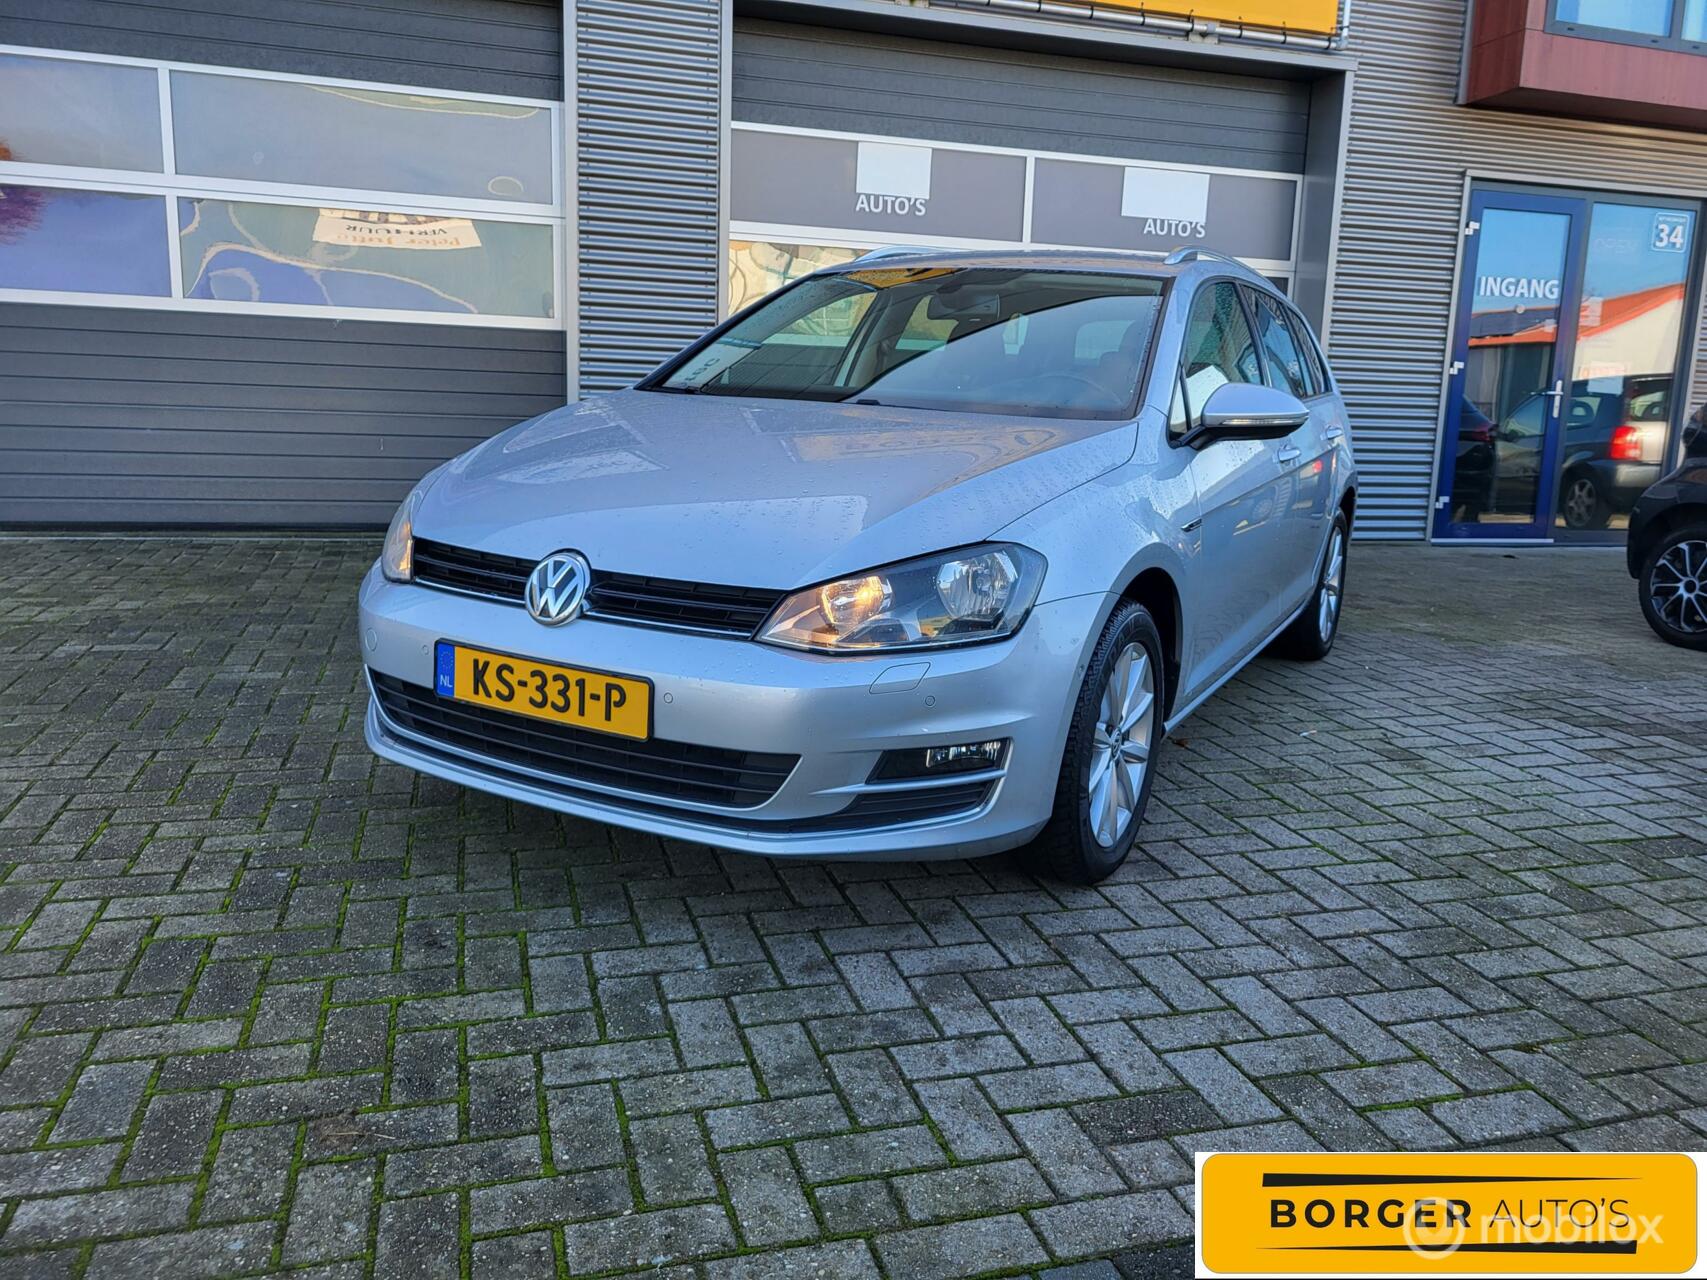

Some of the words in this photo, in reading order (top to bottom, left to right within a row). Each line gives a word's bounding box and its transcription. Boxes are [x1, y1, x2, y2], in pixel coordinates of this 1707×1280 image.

[856, 195, 926, 216] AUTO'S
[1143, 218, 1206, 238] AUTO'S
[1655, 224, 1684, 248] 34
[1479, 276, 1560, 299] INGANG
[439, 674, 453, 688] NL
[472, 658, 627, 722] KS-331-P
